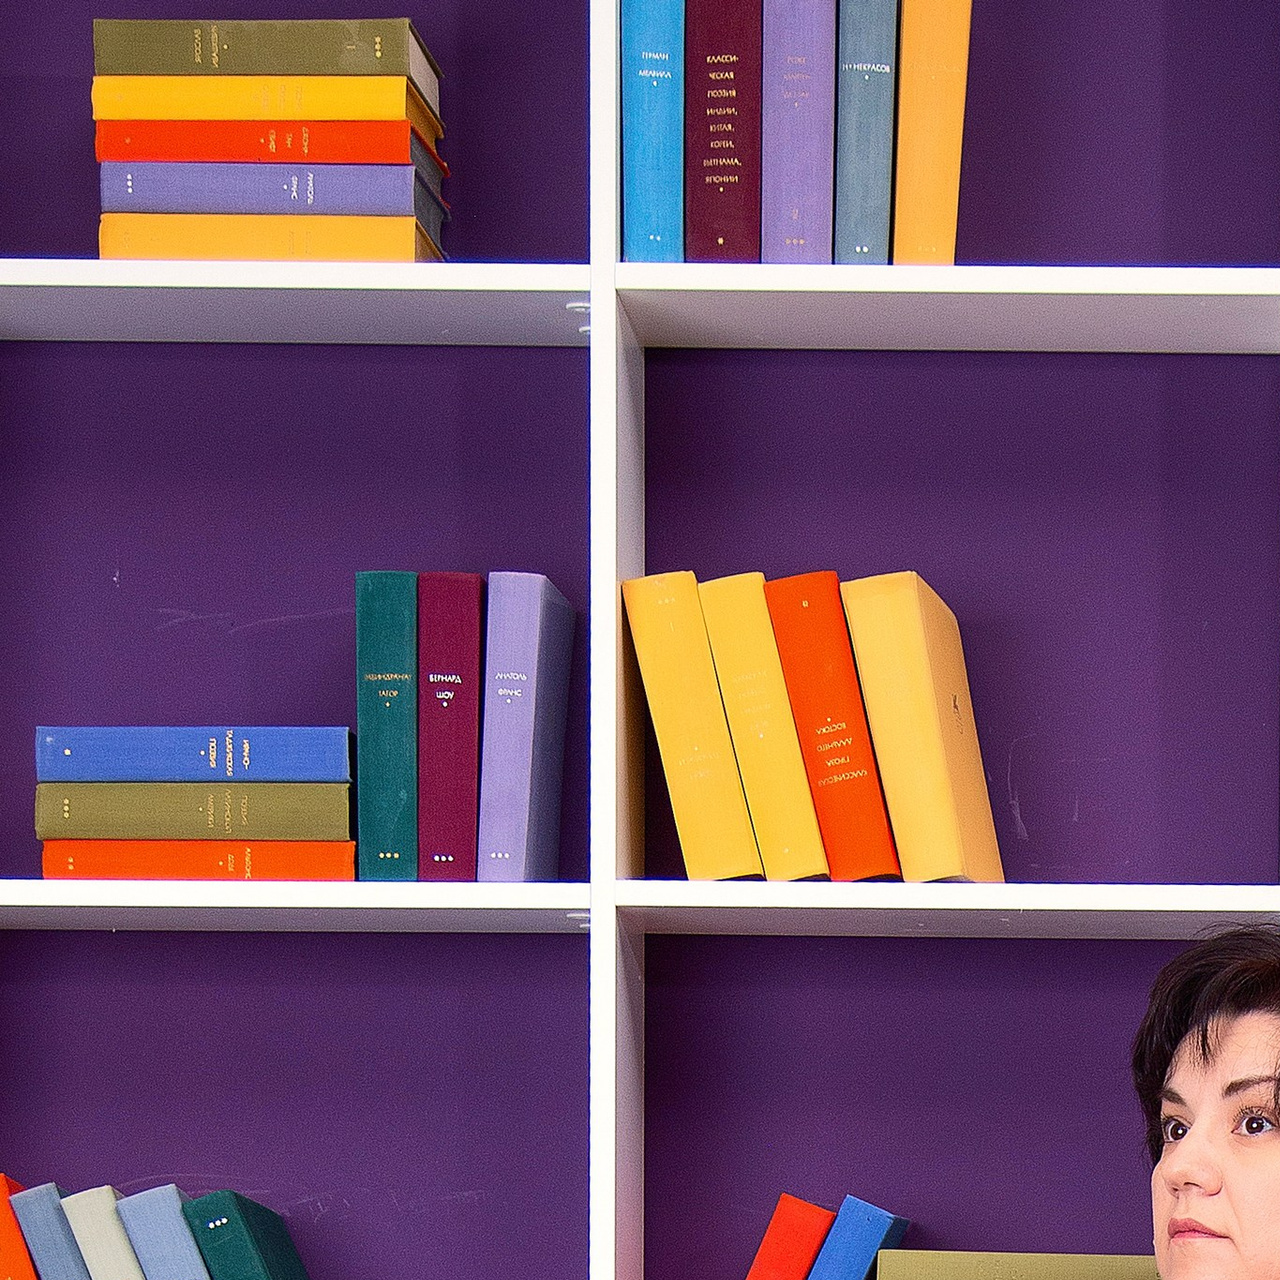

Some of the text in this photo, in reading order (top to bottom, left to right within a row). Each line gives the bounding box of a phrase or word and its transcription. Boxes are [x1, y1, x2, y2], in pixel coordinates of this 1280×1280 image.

[706, 54, 739, 64] КЛАССИ-
[708, 71, 735, 80] ЧЕСКАЯ
[706, 88, 737, 99] ПОЭЗИЯ
[706, 106, 738, 116] ИНДИИ,
[708, 123, 735, 133] КИТАЯ,
[709, 139, 735, 149] КОРЕИ,
[703, 157, 742, 168] ВЬЕТНАМА,
[704, 174, 739, 185] ЯПОНИИ
[428, 673, 463, 684] БЕРНАРД
[495, 672, 528, 681] АНАТОЛЬ
[436, 691, 455, 700] ШОУ
[497, 688, 523, 697] ФРАНС
[815, 721, 847, 736] ВОСТОКА
[816, 737, 853, 753] ДАЛЬНЕГО
[208, 737, 217, 769] ПОЭЗИЯ
[225, 728, 234, 777] ТАДЖИКСКАЯ
[242, 738, 250, 771] ИРАНО-
[825, 755, 850, 767] ПРОЗА
[816, 769, 868, 788] КЛАССИЧЕСКАЯ
